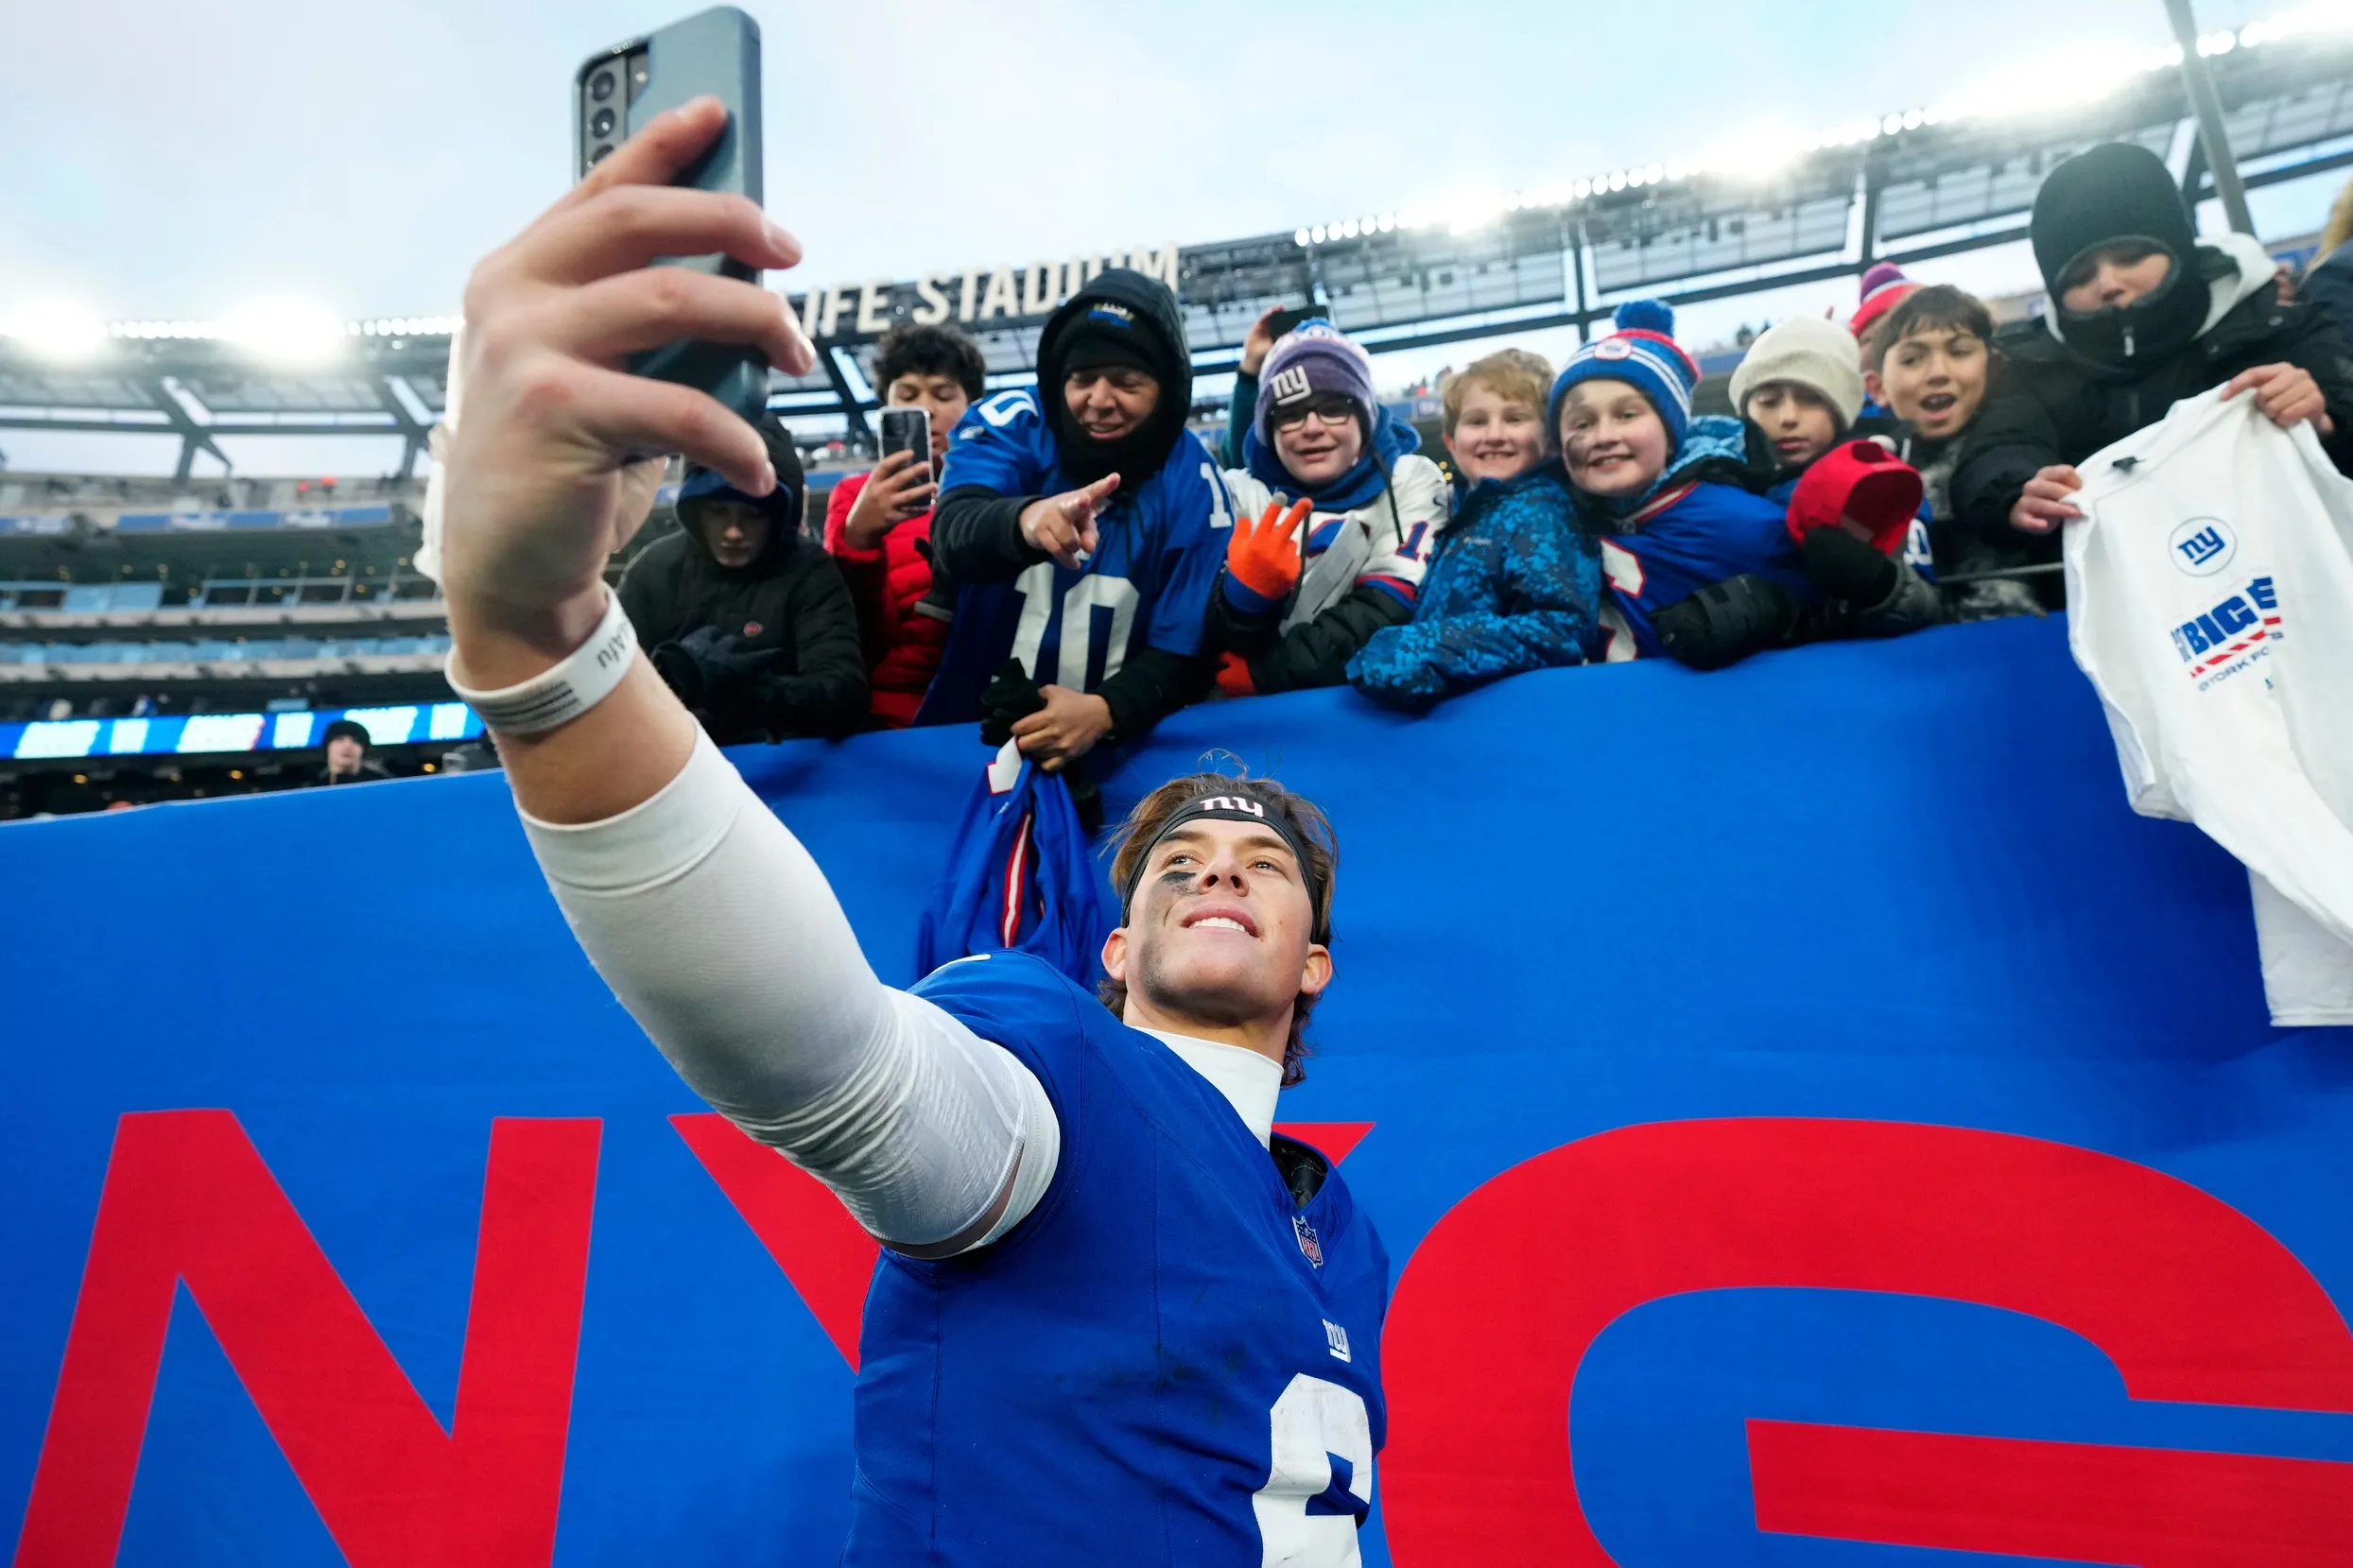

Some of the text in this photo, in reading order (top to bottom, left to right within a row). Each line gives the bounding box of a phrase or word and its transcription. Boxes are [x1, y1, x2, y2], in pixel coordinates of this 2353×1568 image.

[780, 278, 892, 338] IFE
[1008, 560, 1140, 693] 10
[13, 1109, 2353, 1568] NG
